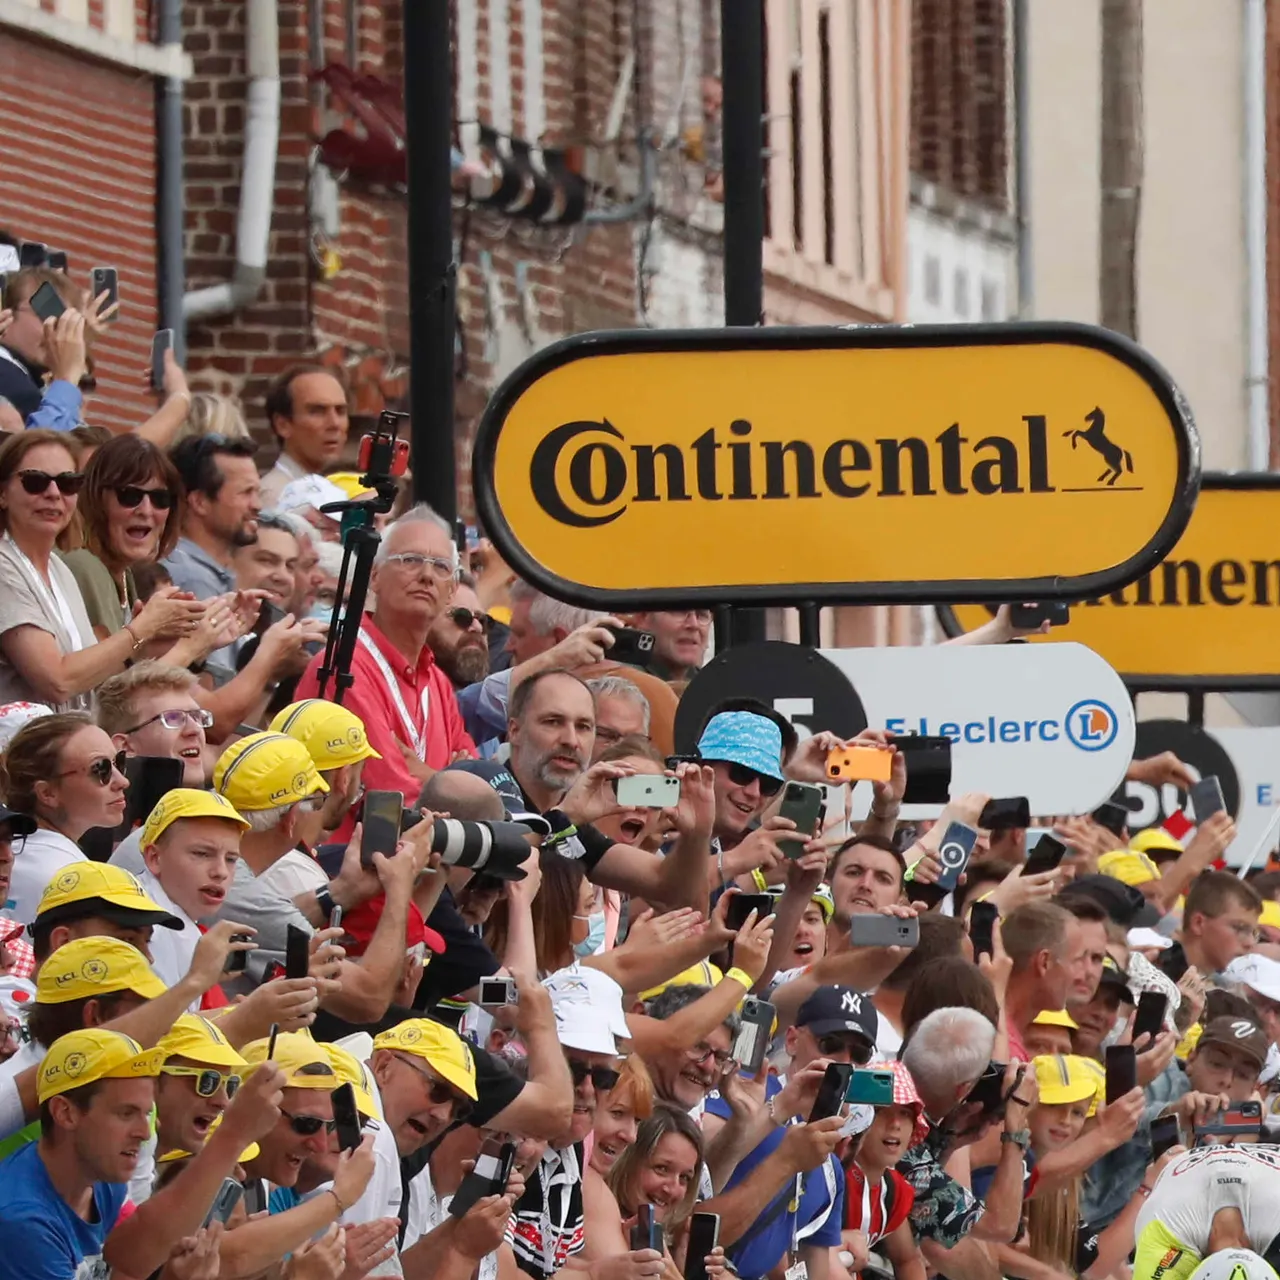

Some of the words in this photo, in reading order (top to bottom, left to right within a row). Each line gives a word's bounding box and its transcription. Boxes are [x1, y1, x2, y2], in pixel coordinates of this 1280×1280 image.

[529, 414, 1056, 528] Continental
[327, 737, 345, 749] LCL
[270, 787, 291, 801] LCL
[56, 972, 78, 984] LCL
[45, 1063, 62, 1077] LCL
